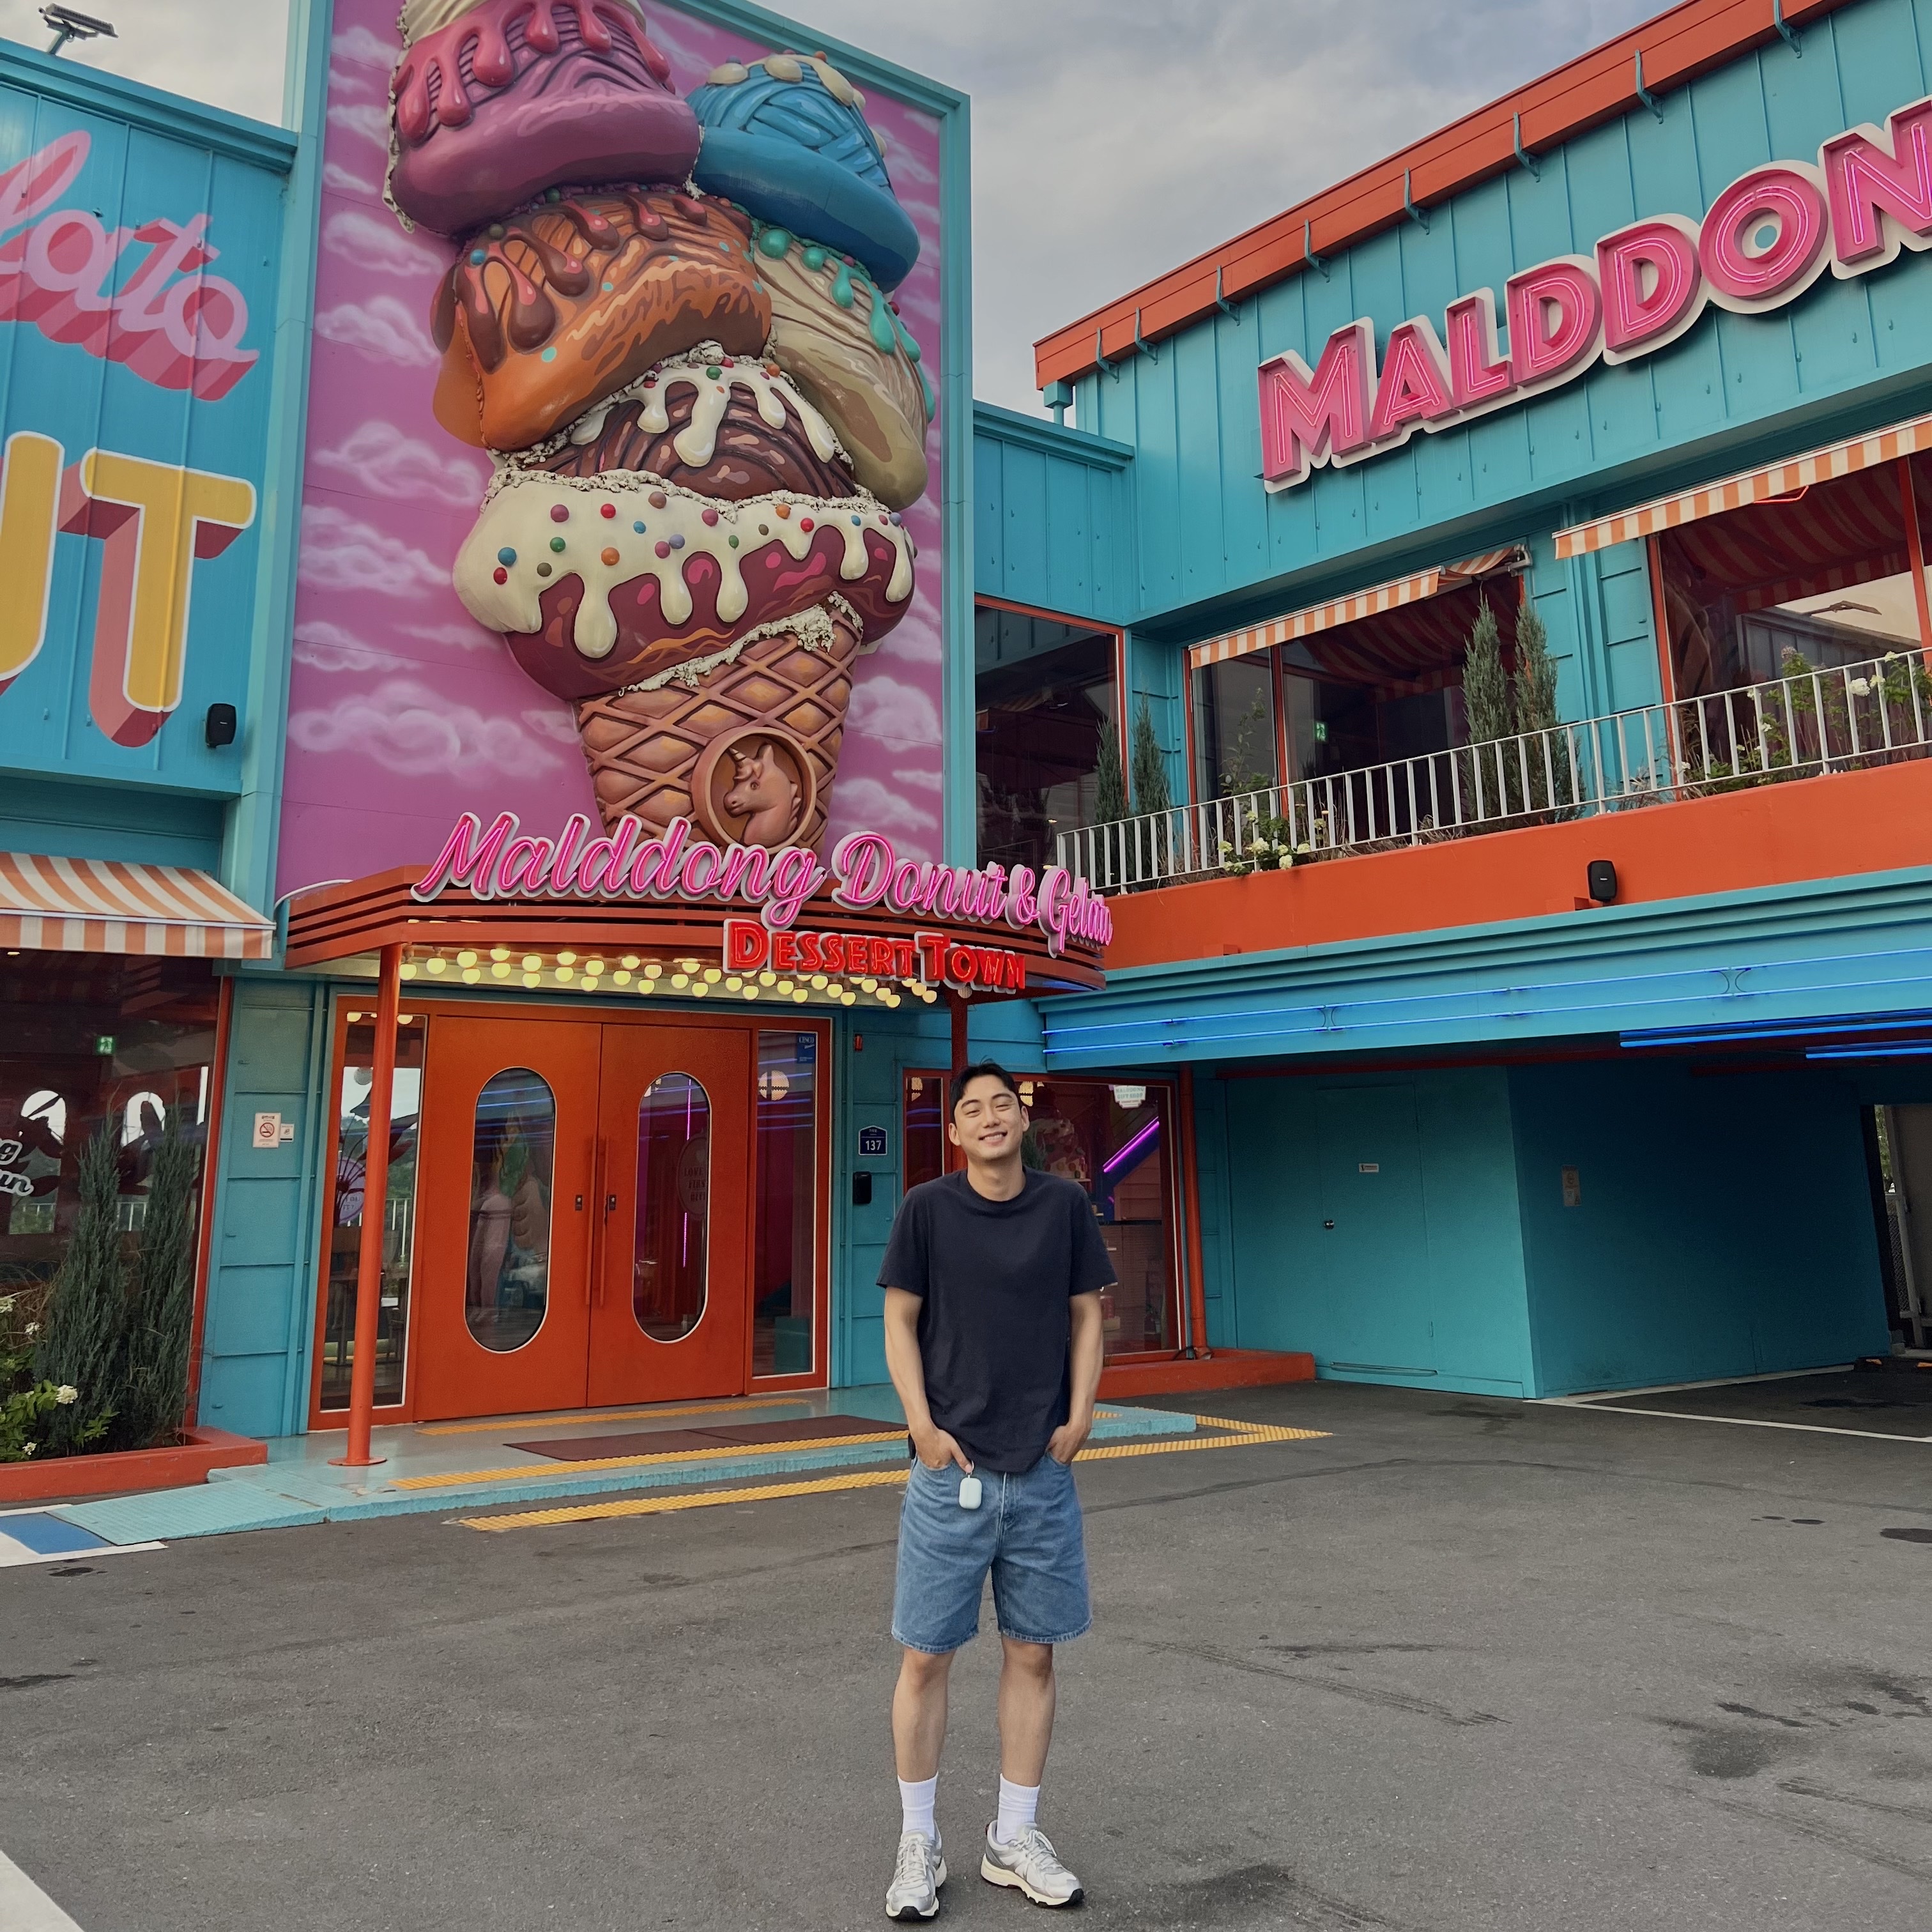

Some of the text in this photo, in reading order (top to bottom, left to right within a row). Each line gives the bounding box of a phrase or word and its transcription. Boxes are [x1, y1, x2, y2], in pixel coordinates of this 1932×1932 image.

[1257, 95, 1932, 487] MALDDON
[411, 811, 827, 929] Malddong
[832, 831, 1008, 922] Donut
[1006, 864, 1041, 930] &
[723, 919, 1025, 994] DESSERT TOWN
[684, 1167, 704, 1177] LOVE
[866, 1140, 882, 1151] 137
